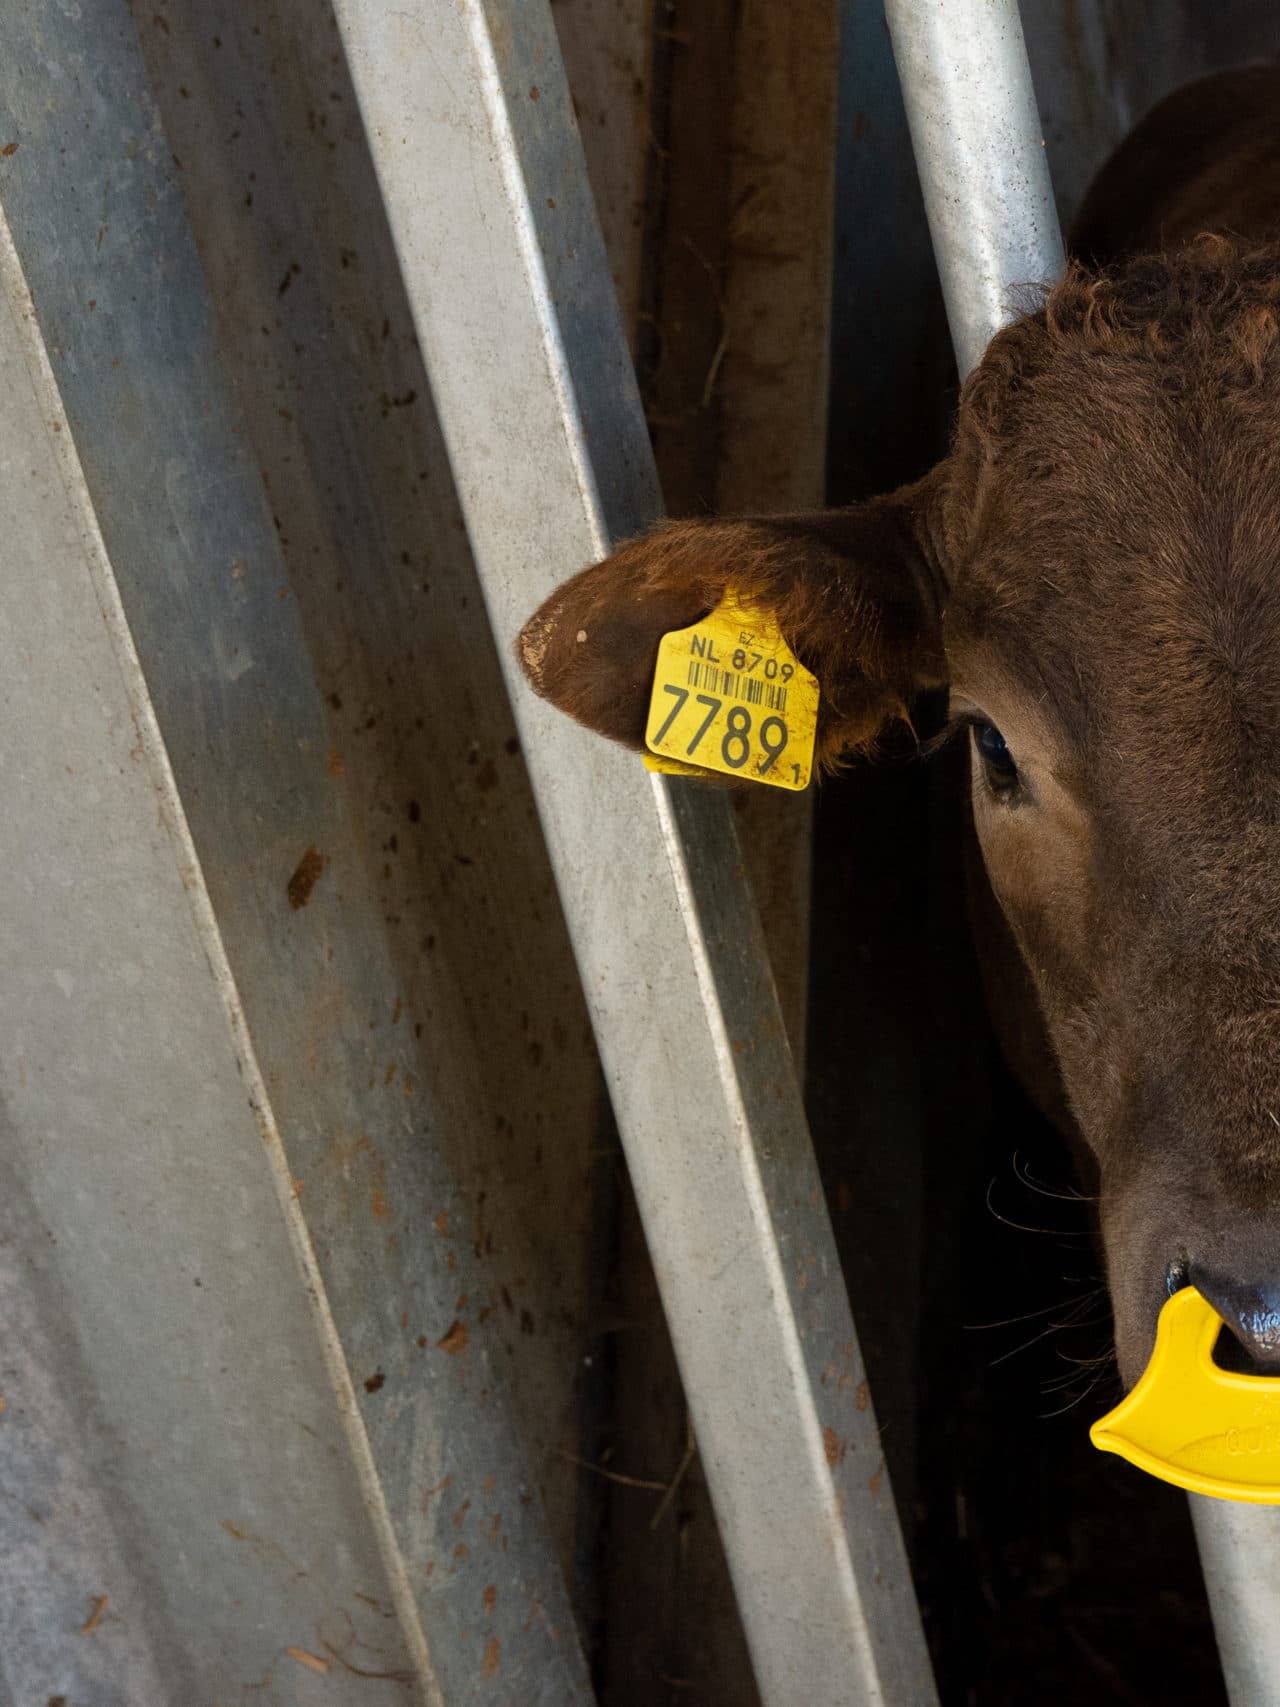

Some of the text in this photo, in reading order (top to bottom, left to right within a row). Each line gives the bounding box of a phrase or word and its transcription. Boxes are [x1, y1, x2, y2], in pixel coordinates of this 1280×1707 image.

[690, 633, 795, 684] NL 8709
[739, 631, 755, 648] EZ
[653, 683, 801, 785] 7789 1
